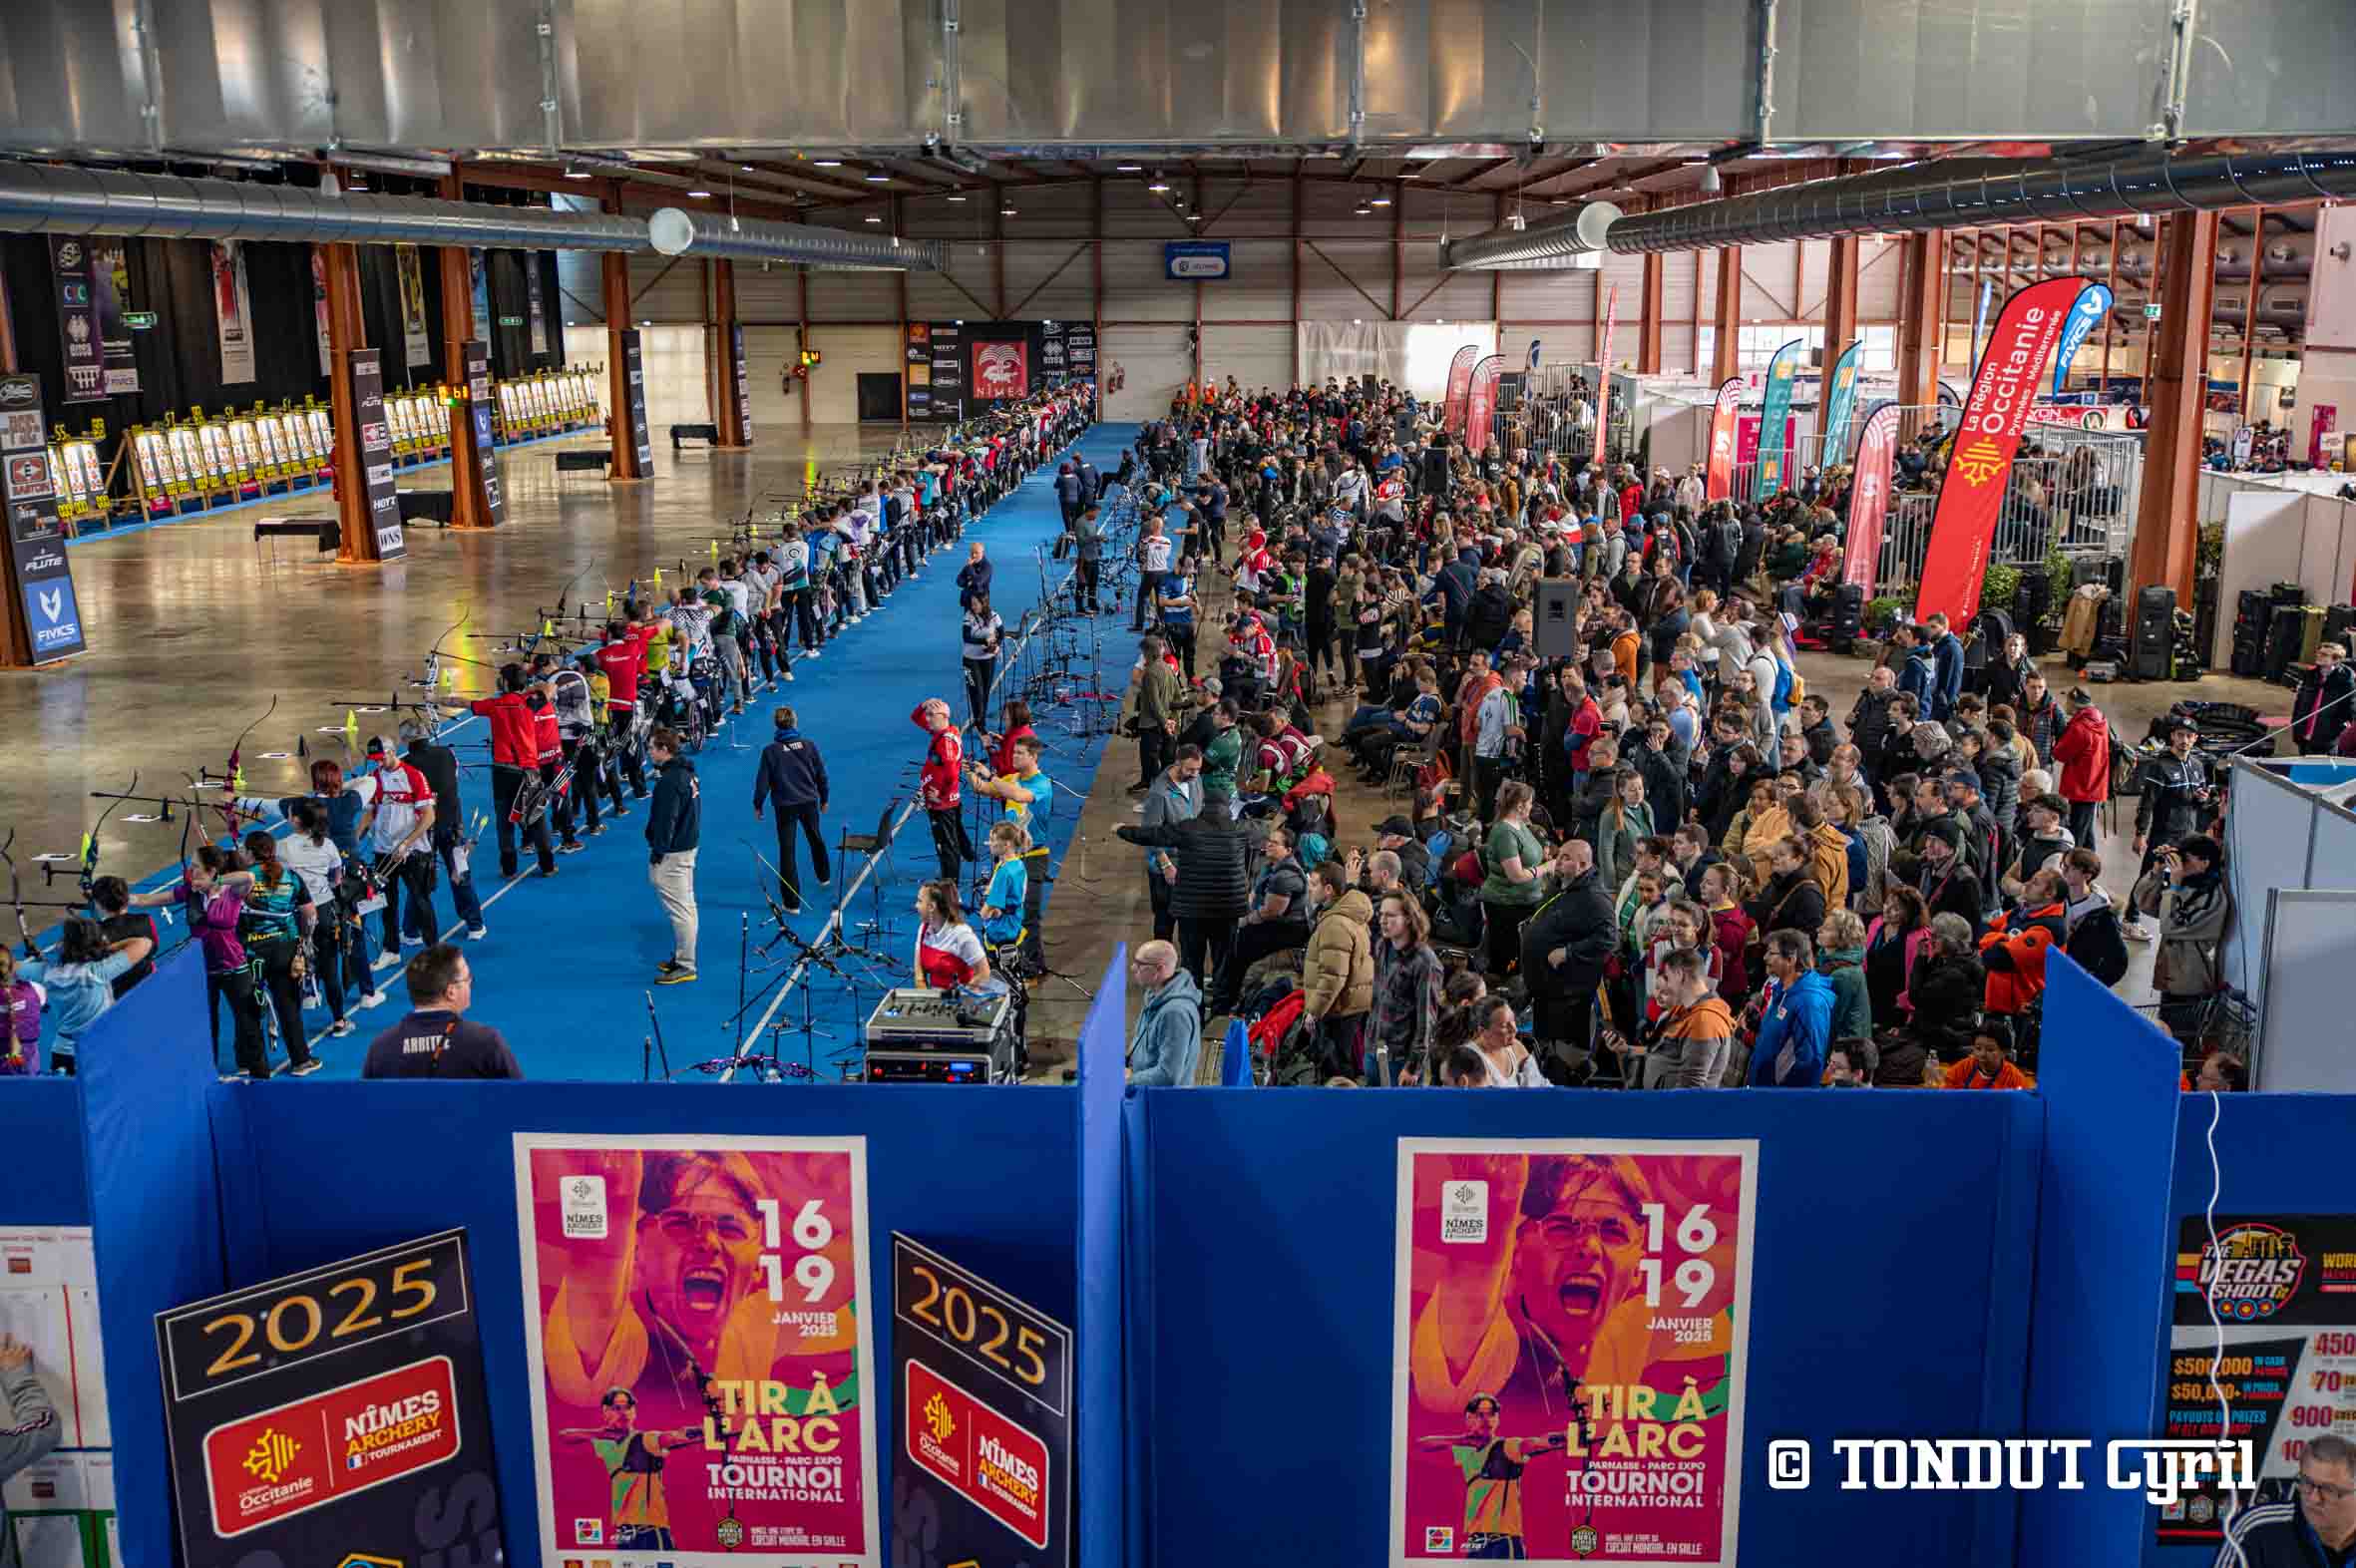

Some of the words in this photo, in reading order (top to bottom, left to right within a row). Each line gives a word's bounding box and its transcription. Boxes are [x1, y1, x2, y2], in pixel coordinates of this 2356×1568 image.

[2060, 317, 2093, 367] FIVICS
[1982, 306, 2045, 434] Occitanie
[2007, 387, 2032, 436] Pyrénées
[2027, 310, 2063, 380] Méditerranée
[1970, 361, 1998, 412] Région
[1964, 415, 1980, 432] La
[373, 496, 396, 510] HOYT
[380, 533, 400, 547] WNS
[25, 557, 63, 572] FLUTE
[38, 623, 75, 641] FIVICS
[403, 1035, 451, 1054] ARBITE
[757, 1199, 833, 1250] 16
[1642, 1203, 1718, 1254] 16
[2199, 1259, 2301, 1283] VEGAS
[2323, 1253, 2356, 1268] WOR
[759, 1255, 835, 1303] 19
[1639, 1259, 1715, 1308] 19
[2213, 1284, 2277, 1299] SHOOT
[203, 1259, 437, 1375] 2025
[772, 1312, 837, 1325] JANVIER
[911, 1266, 1046, 1385] 2025
[1646, 1317, 1713, 1330] JANVIER
[799, 1325, 838, 1338] 2025
[1675, 1330, 1713, 1342] 2025
[2314, 1333, 2356, 1356] 450
[717, 1379, 789, 1415] TIR
[804, 1370, 839, 1415] À
[1586, 1384, 1657, 1420] TIR
[1672, 1374, 1708, 1420] À
[344, 1389, 440, 1441] NÎMES
[2292, 1405, 2332, 1426] 900
[345, 1411, 442, 1455] ARCHERY
[368, 1428, 443, 1461] TOURNAMENT
[703, 1415, 841, 1453] L'ARC
[1567, 1421, 1707, 1458] L'ARC
[784, 1455, 812, 1465] PARC
[814, 1456, 843, 1466] EXPO
[980, 1434, 1037, 1491] NÎMES
[1589, 1461, 1640, 1470] PARNASSE
[706, 1463, 842, 1490] TOURNOI
[979, 1458, 1037, 1506] ARCHERY
[1566, 1470, 1704, 1494] TOURNOI
[239, 1476, 313, 1509] Occitanie
[708, 1486, 844, 1503] INTERNATIONAL
[1564, 1494, 1704, 1507] INTERNATIONAL
